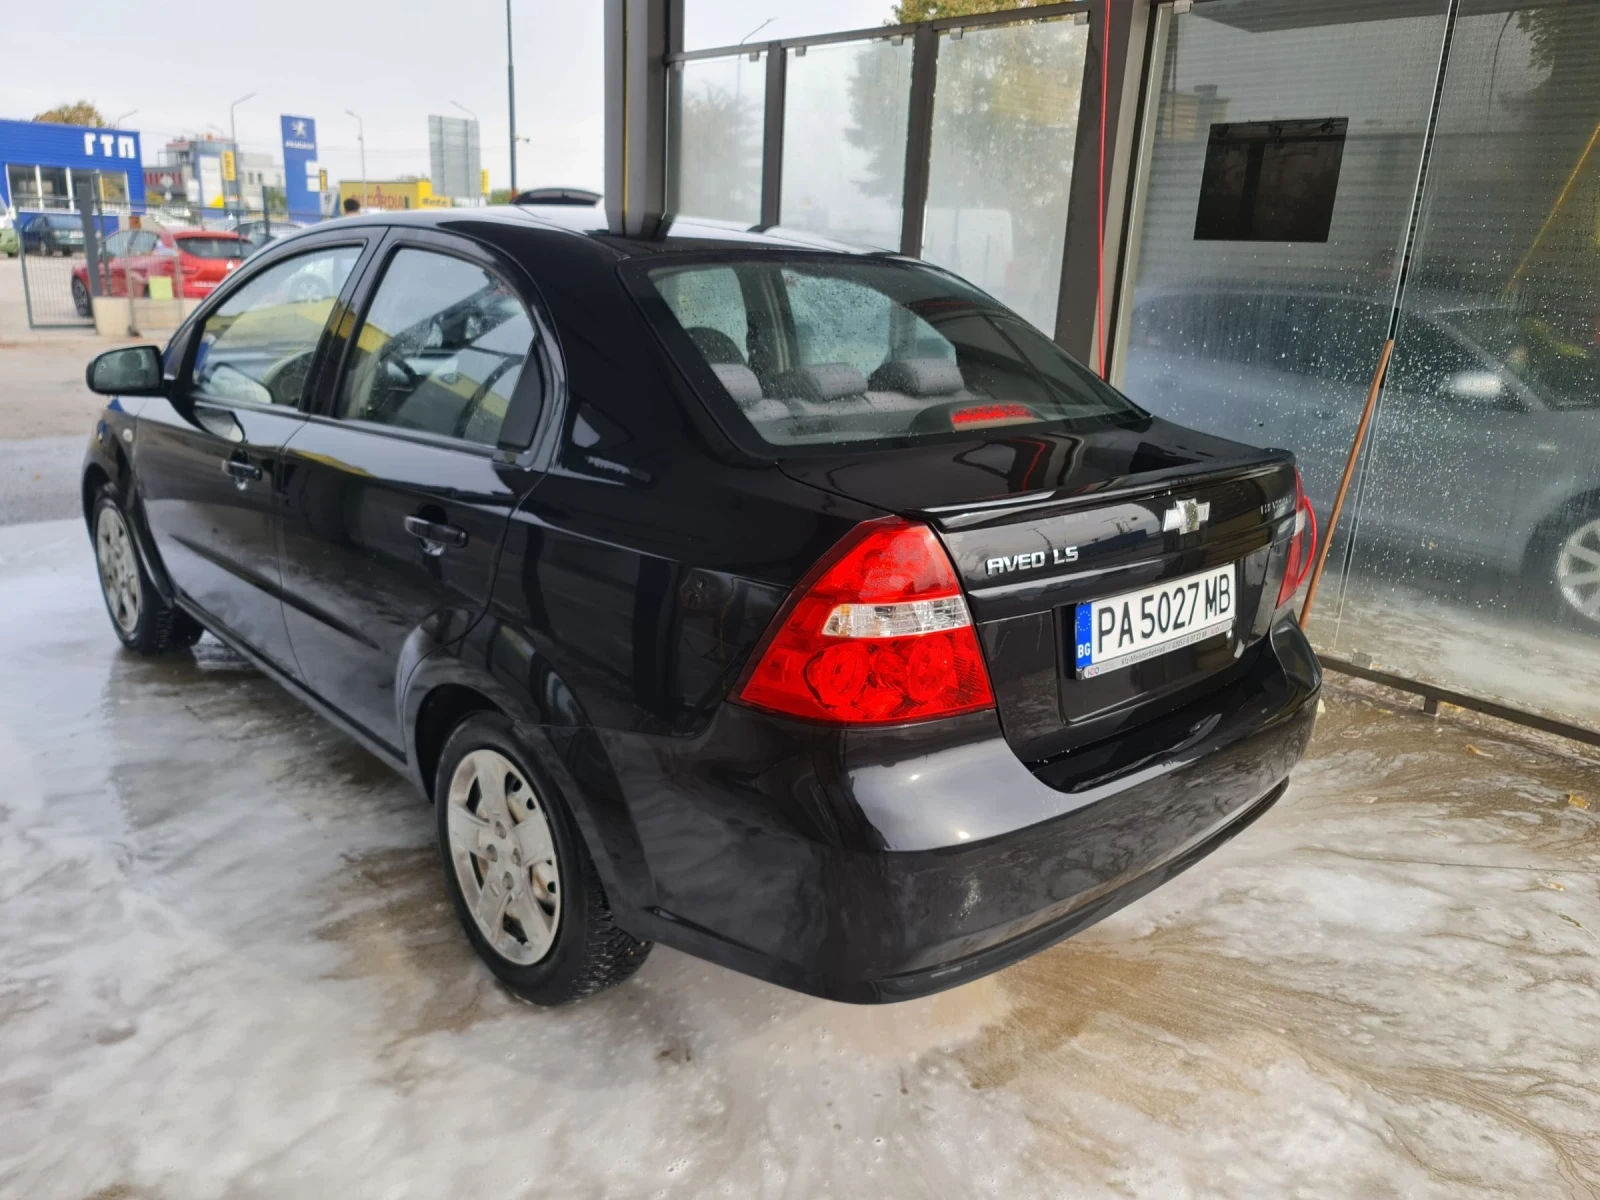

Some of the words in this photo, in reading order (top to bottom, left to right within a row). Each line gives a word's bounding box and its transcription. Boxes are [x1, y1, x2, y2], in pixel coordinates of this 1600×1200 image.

[84, 132, 135, 159] ГТП
[985, 551, 1046, 575] AVEO
[1053, 546, 1079, 565] LS
[1098, 601, 1135, 654] PA
[1141, 581, 1200, 639] 5027
[1205, 573, 1231, 620] MB
[1077, 643, 1091, 659] BG
